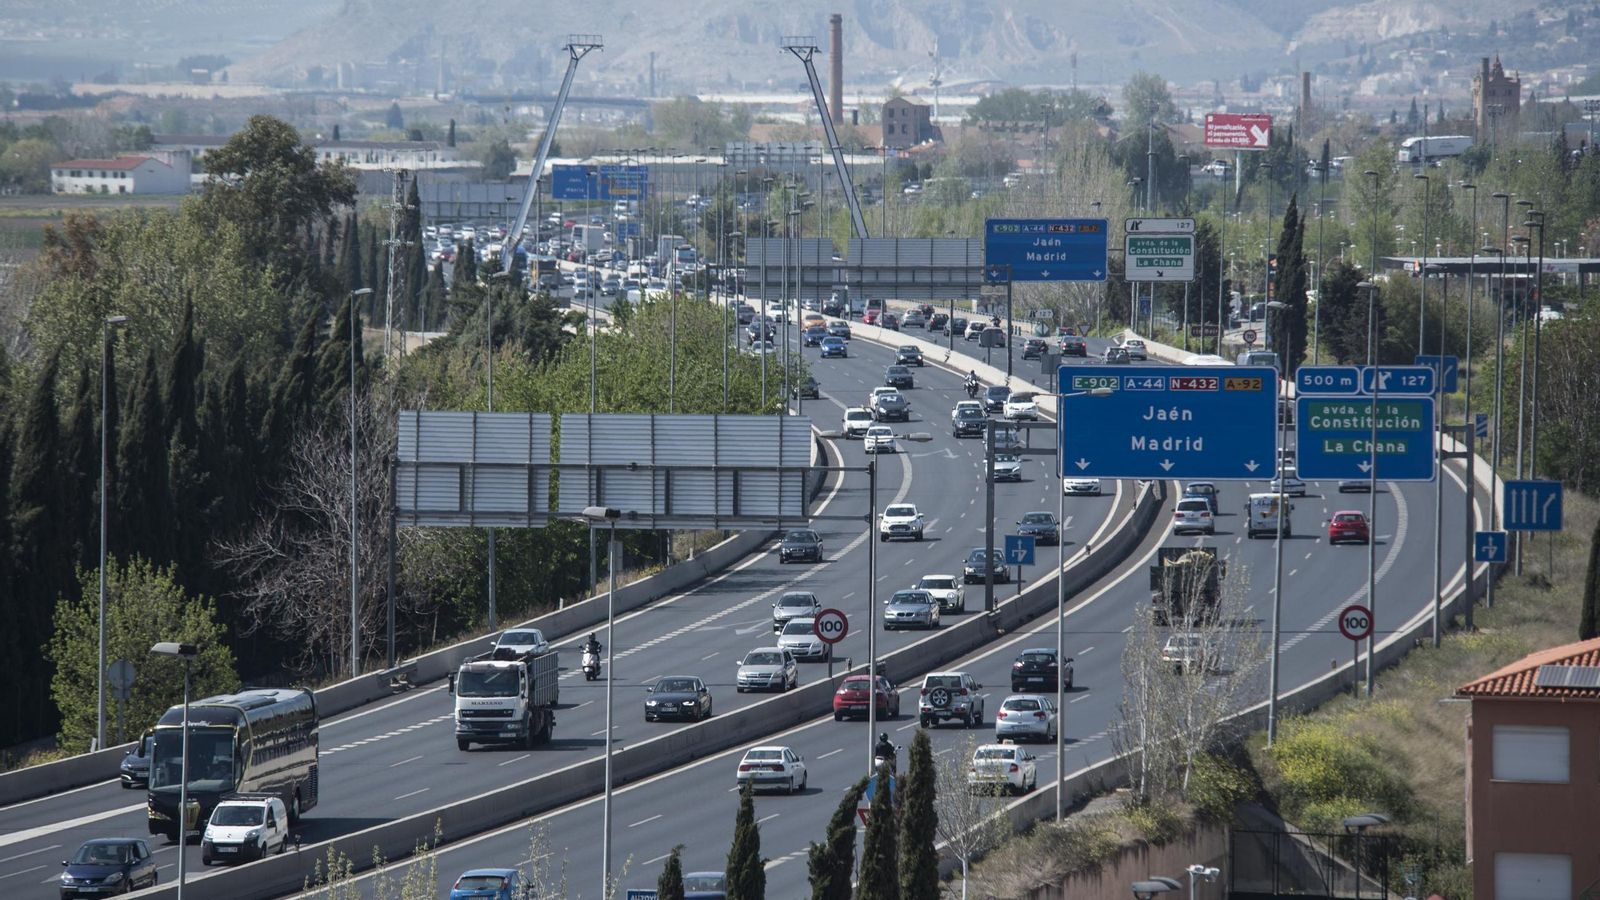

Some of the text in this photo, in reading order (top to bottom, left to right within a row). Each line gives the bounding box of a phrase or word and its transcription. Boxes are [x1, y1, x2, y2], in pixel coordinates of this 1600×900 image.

[1033, 238, 1061, 246] Jaén
[1129, 246, 1190, 254] Constitución
[1026, 252, 1066, 261] Madrid
[1074, 377, 1261, 390] E-902 A-44 N-432 A-92
[1304, 376, 1352, 386] 500 m
[1401, 376, 1426, 386] 127
[1143, 406, 1193, 421] Jaén
[1322, 406, 1358, 415] avda.
[1387, 405, 1398, 415] la
[1311, 416, 1420, 428] Constitución
[1131, 436, 1203, 451] Madrid
[1324, 440, 1406, 452] La Chana
[820, 620, 843, 632] 100
[1345, 617, 1368, 629] 100
